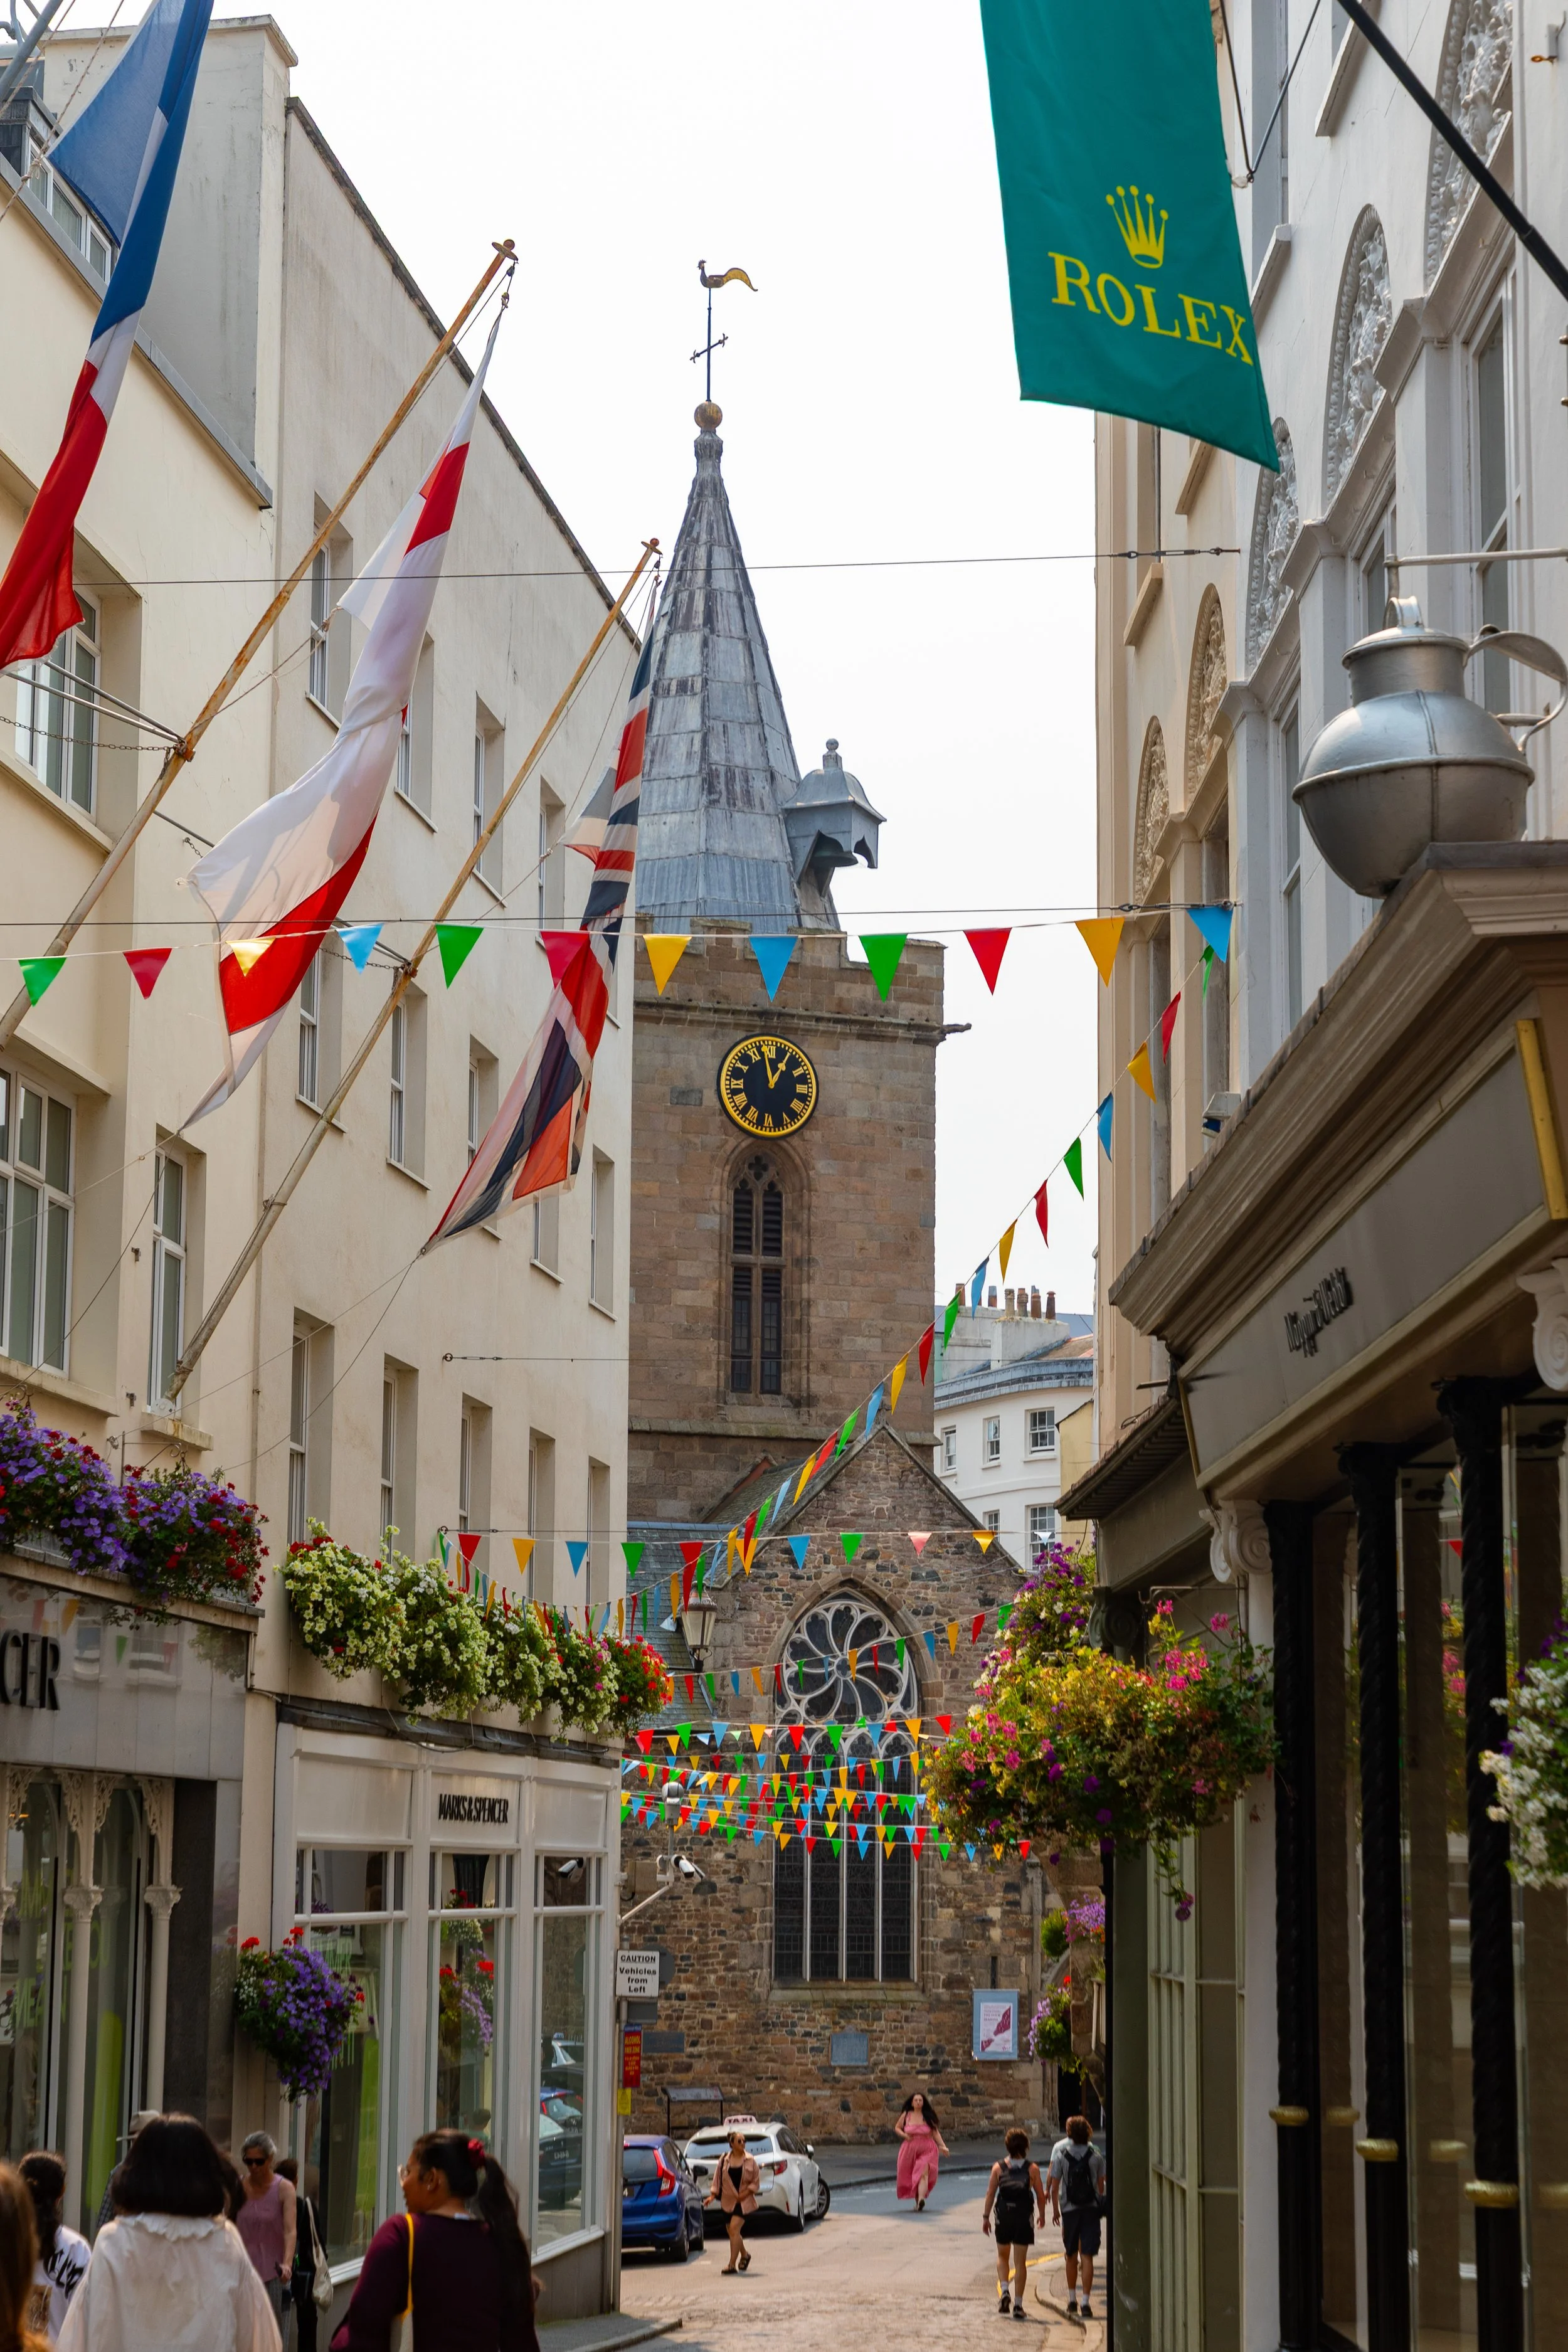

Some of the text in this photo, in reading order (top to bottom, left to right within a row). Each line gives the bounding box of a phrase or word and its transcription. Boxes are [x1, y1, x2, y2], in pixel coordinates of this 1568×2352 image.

[1048, 251, 1253, 366] ROLEX
[746, 1047, 760, 1062] XI
[735, 1060, 748, 1072] X
[792, 1066, 803, 1076] II
[731, 1078, 743, 1088] IX
[796, 1084, 807, 1093] III
[733, 1092, 746, 1109] VIII
[790, 1098, 803, 1113] IIII
[745, 1105, 758, 1122] VII
[763, 1113, 773, 1126] VI
[782, 1111, 790, 1123] V
[620, 1954, 656, 1963] CAUTION
[619, 1967, 657, 1975] Vehicles
[628, 1985, 645, 1993] Left
[625, 2036, 640, 2045] ALCOHOL
